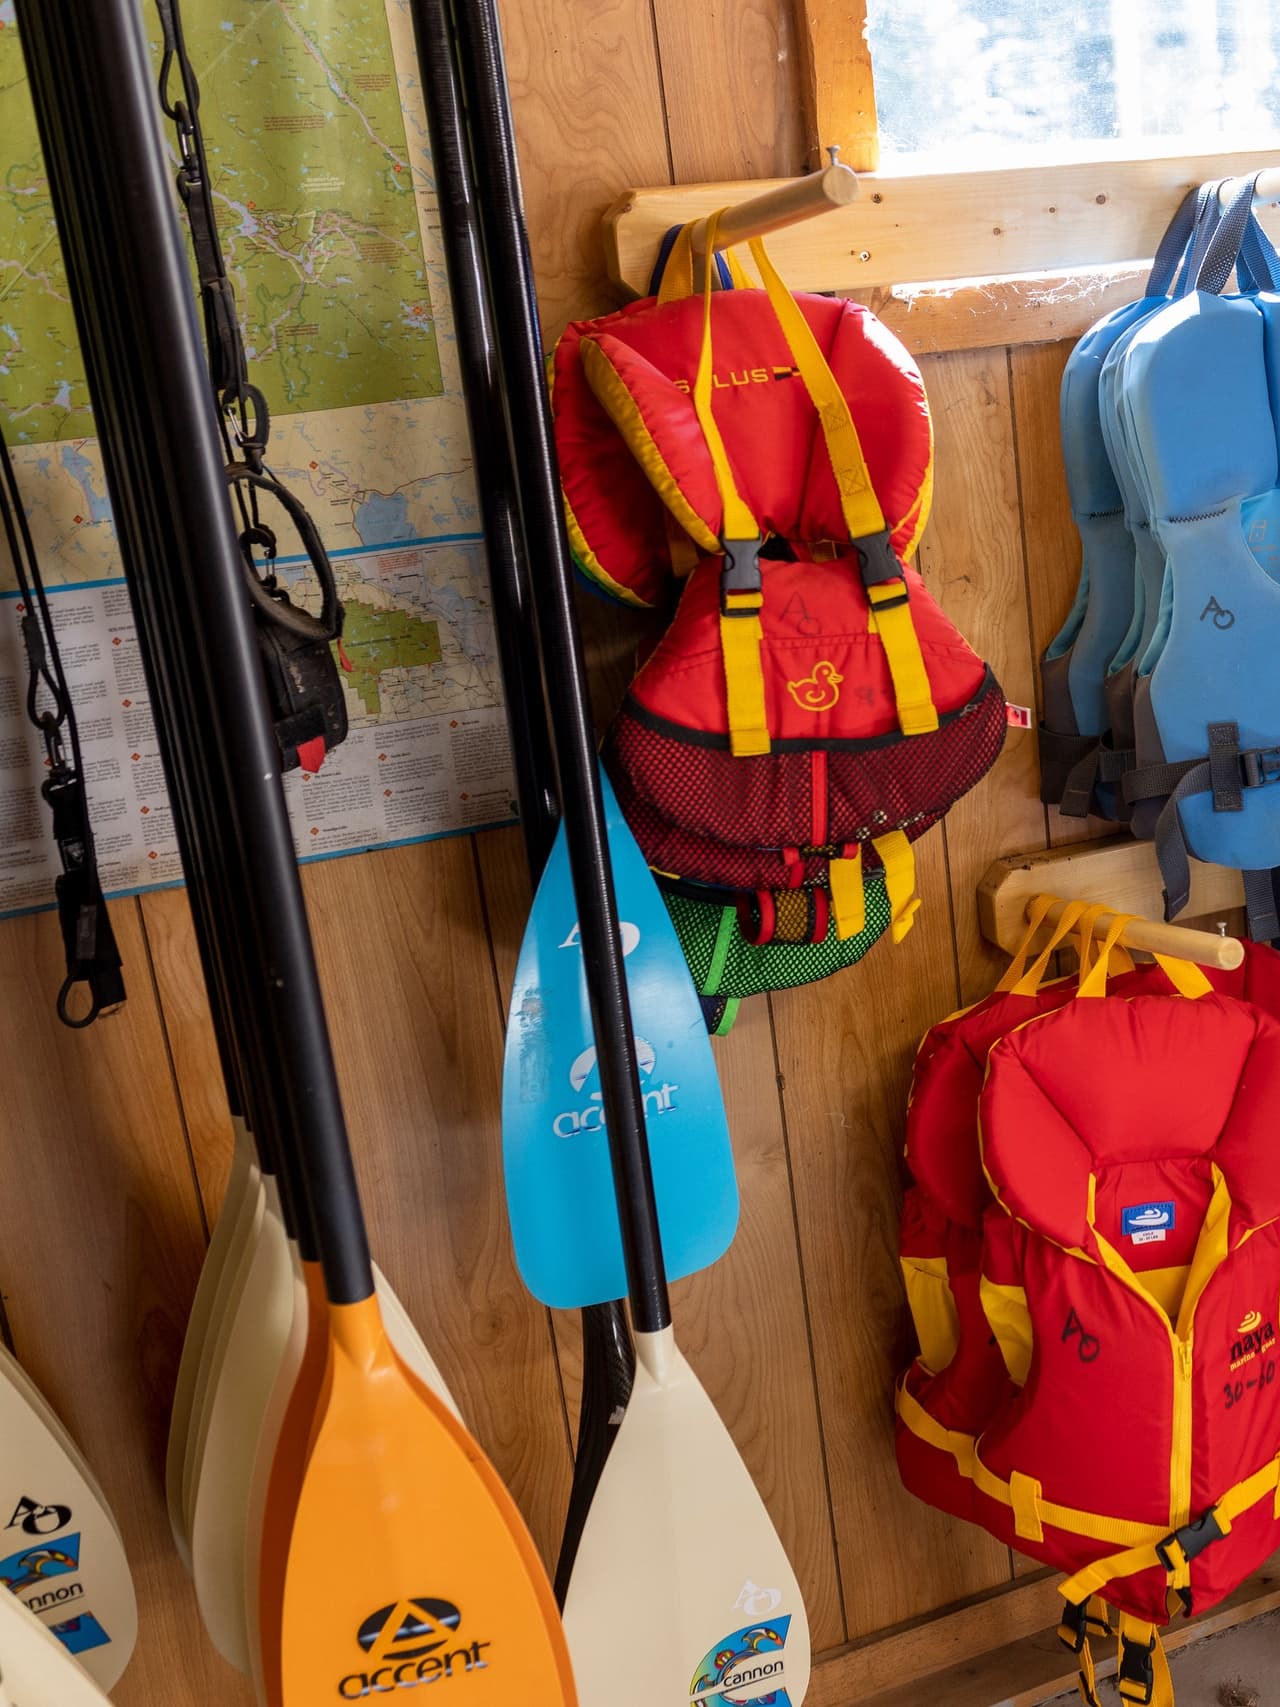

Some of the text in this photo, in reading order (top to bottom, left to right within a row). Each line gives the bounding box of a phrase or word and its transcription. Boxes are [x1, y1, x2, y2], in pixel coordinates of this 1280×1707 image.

[672, 367, 769, 394] SLUS
[553, 1083, 680, 1138] acnt
[1229, 1321, 1275, 1362] naya
[1229, 1351, 1256, 1372] marine
[22, 1583, 84, 1610] nnon
[338, 1640, 491, 1700] accent
[723, 1660, 784, 1688] cannon
